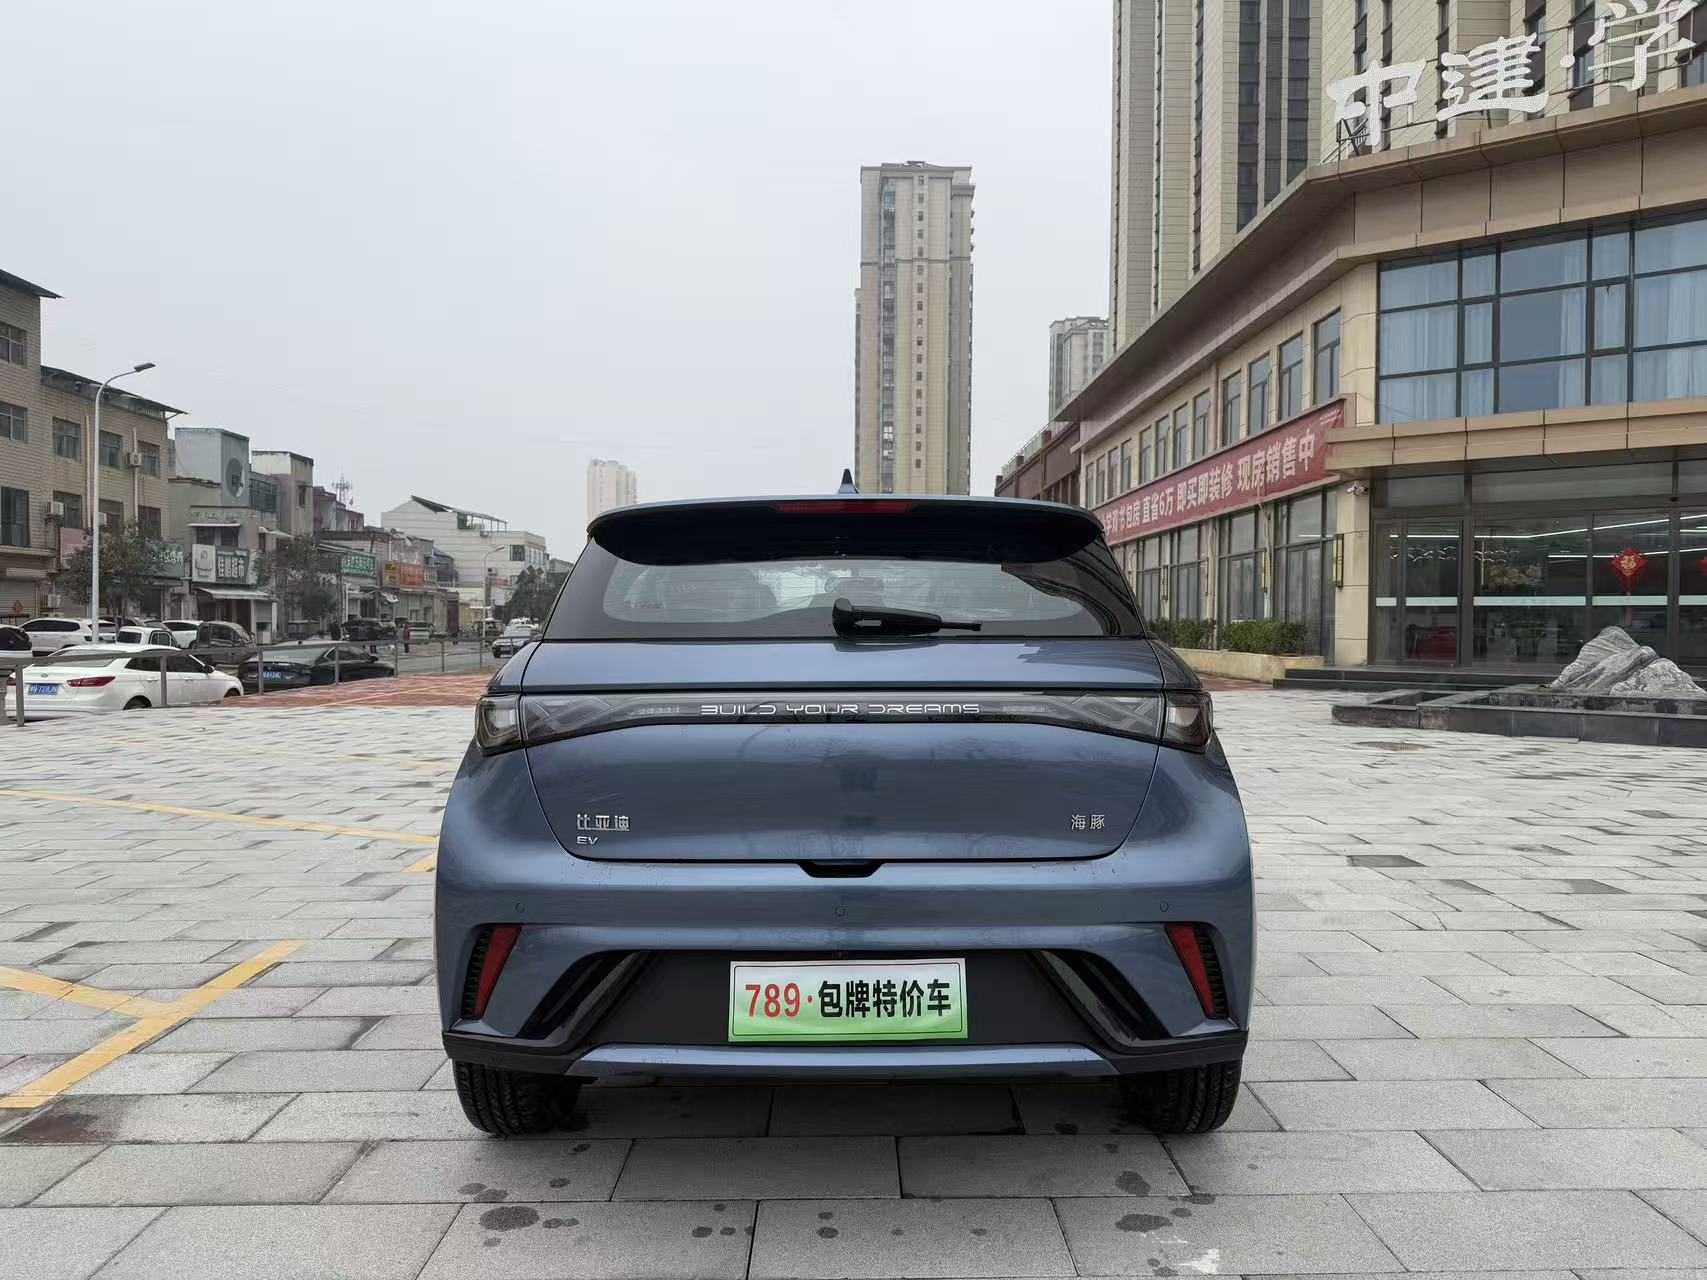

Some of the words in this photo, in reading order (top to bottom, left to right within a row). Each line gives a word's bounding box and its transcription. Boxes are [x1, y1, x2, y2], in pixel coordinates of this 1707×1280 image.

[1237, 428, 1315, 492] 现房销售中
[700, 704, 777, 715] BUILD
[785, 704, 859, 715] YOUR
[868, 703, 980, 714] DREAMS
[576, 813, 630, 832] 比亚迪
[1071, 813, 1105, 830] 海豚
[576, 836, 599, 845] EV
